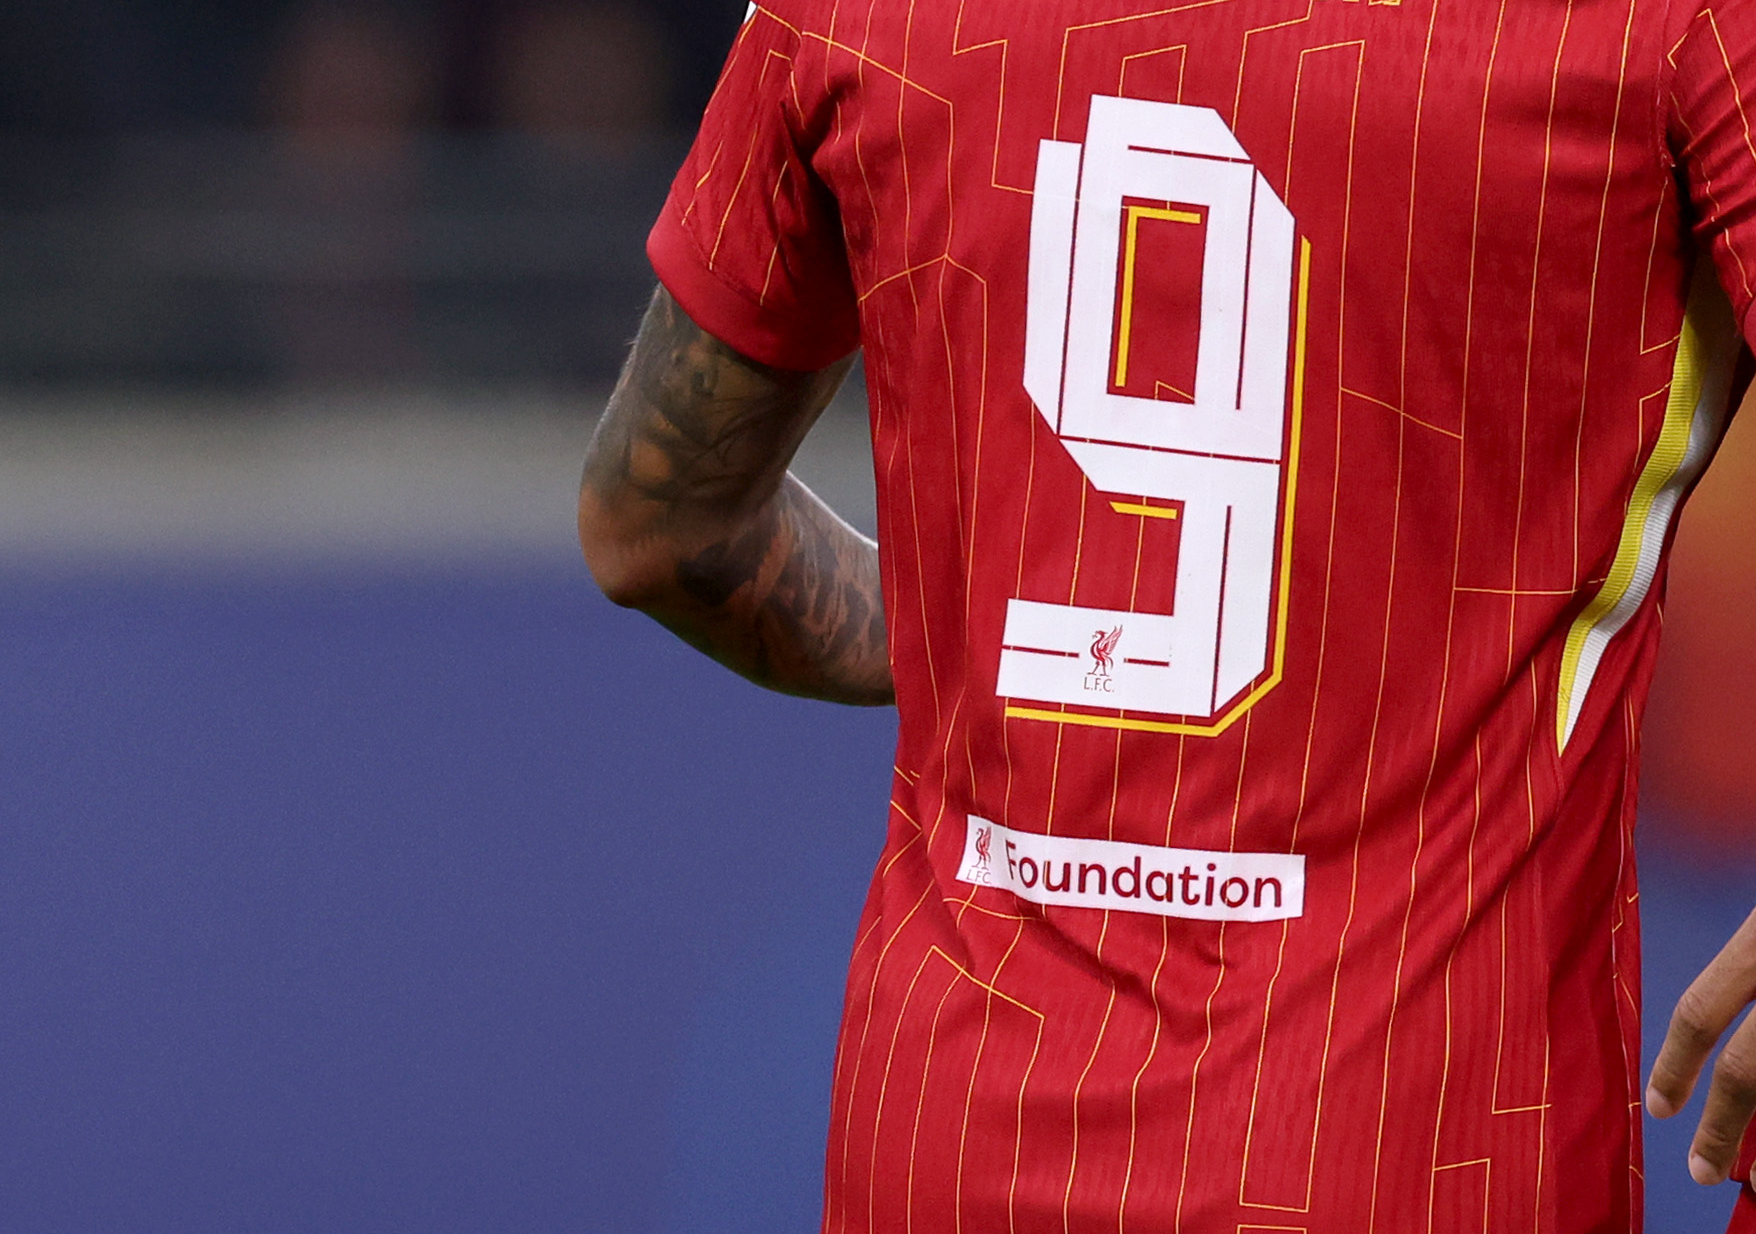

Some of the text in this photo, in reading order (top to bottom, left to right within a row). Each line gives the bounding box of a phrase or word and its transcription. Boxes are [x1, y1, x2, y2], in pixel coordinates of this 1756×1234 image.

[996, 94, 1311, 737] 9
[1083, 676, 1115, 693] L.F.C.
[1005, 839, 1283, 909] Foundation
